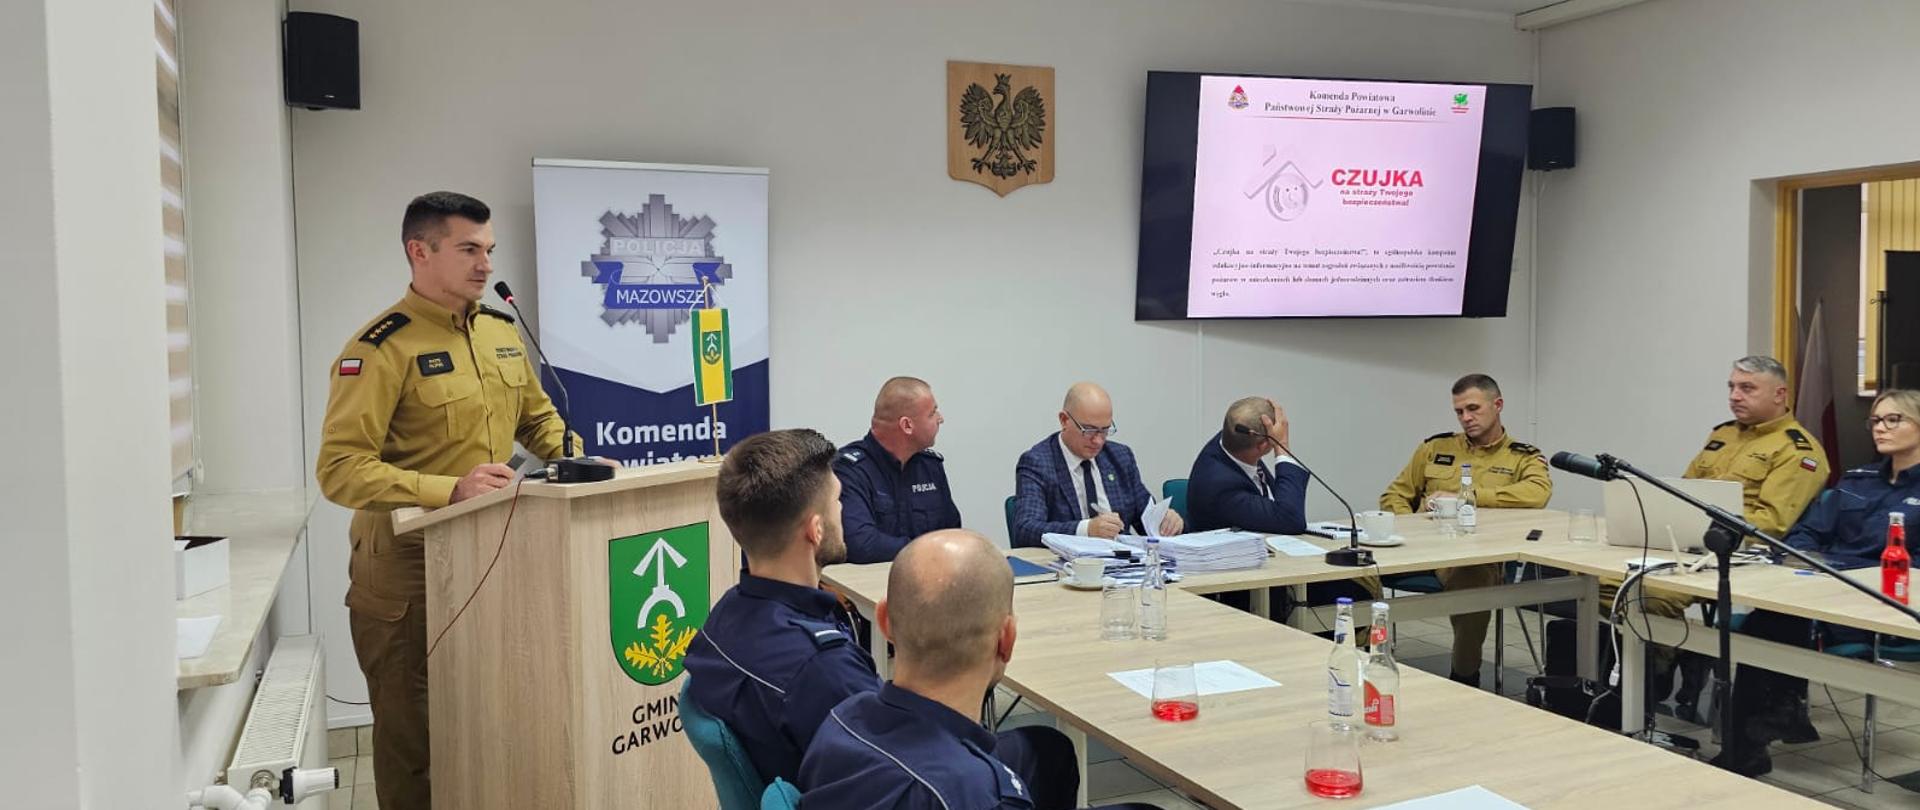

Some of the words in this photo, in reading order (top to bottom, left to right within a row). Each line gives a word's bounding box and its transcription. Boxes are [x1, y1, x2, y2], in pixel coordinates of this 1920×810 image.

[1309, 90, 1349, 101] Komenda
[1351, 92, 1396, 103] Powiatowa
[1264, 102, 1315, 114] Państwowej
[1316, 103, 1344, 115] Straży
[1345, 104, 1381, 117] Pożarnej
[1392, 107, 1436, 117] Garwolinie
[1331, 169, 1424, 187] CZUJKA
[1380, 189, 1413, 198] Twojego
[616, 240, 701, 255] POLICJA
[616, 289, 705, 304] MAZOWSZE
[596, 416, 727, 446] Komenda
[632, 692, 681, 725] GMIN
[611, 716, 684, 755] GARWO
